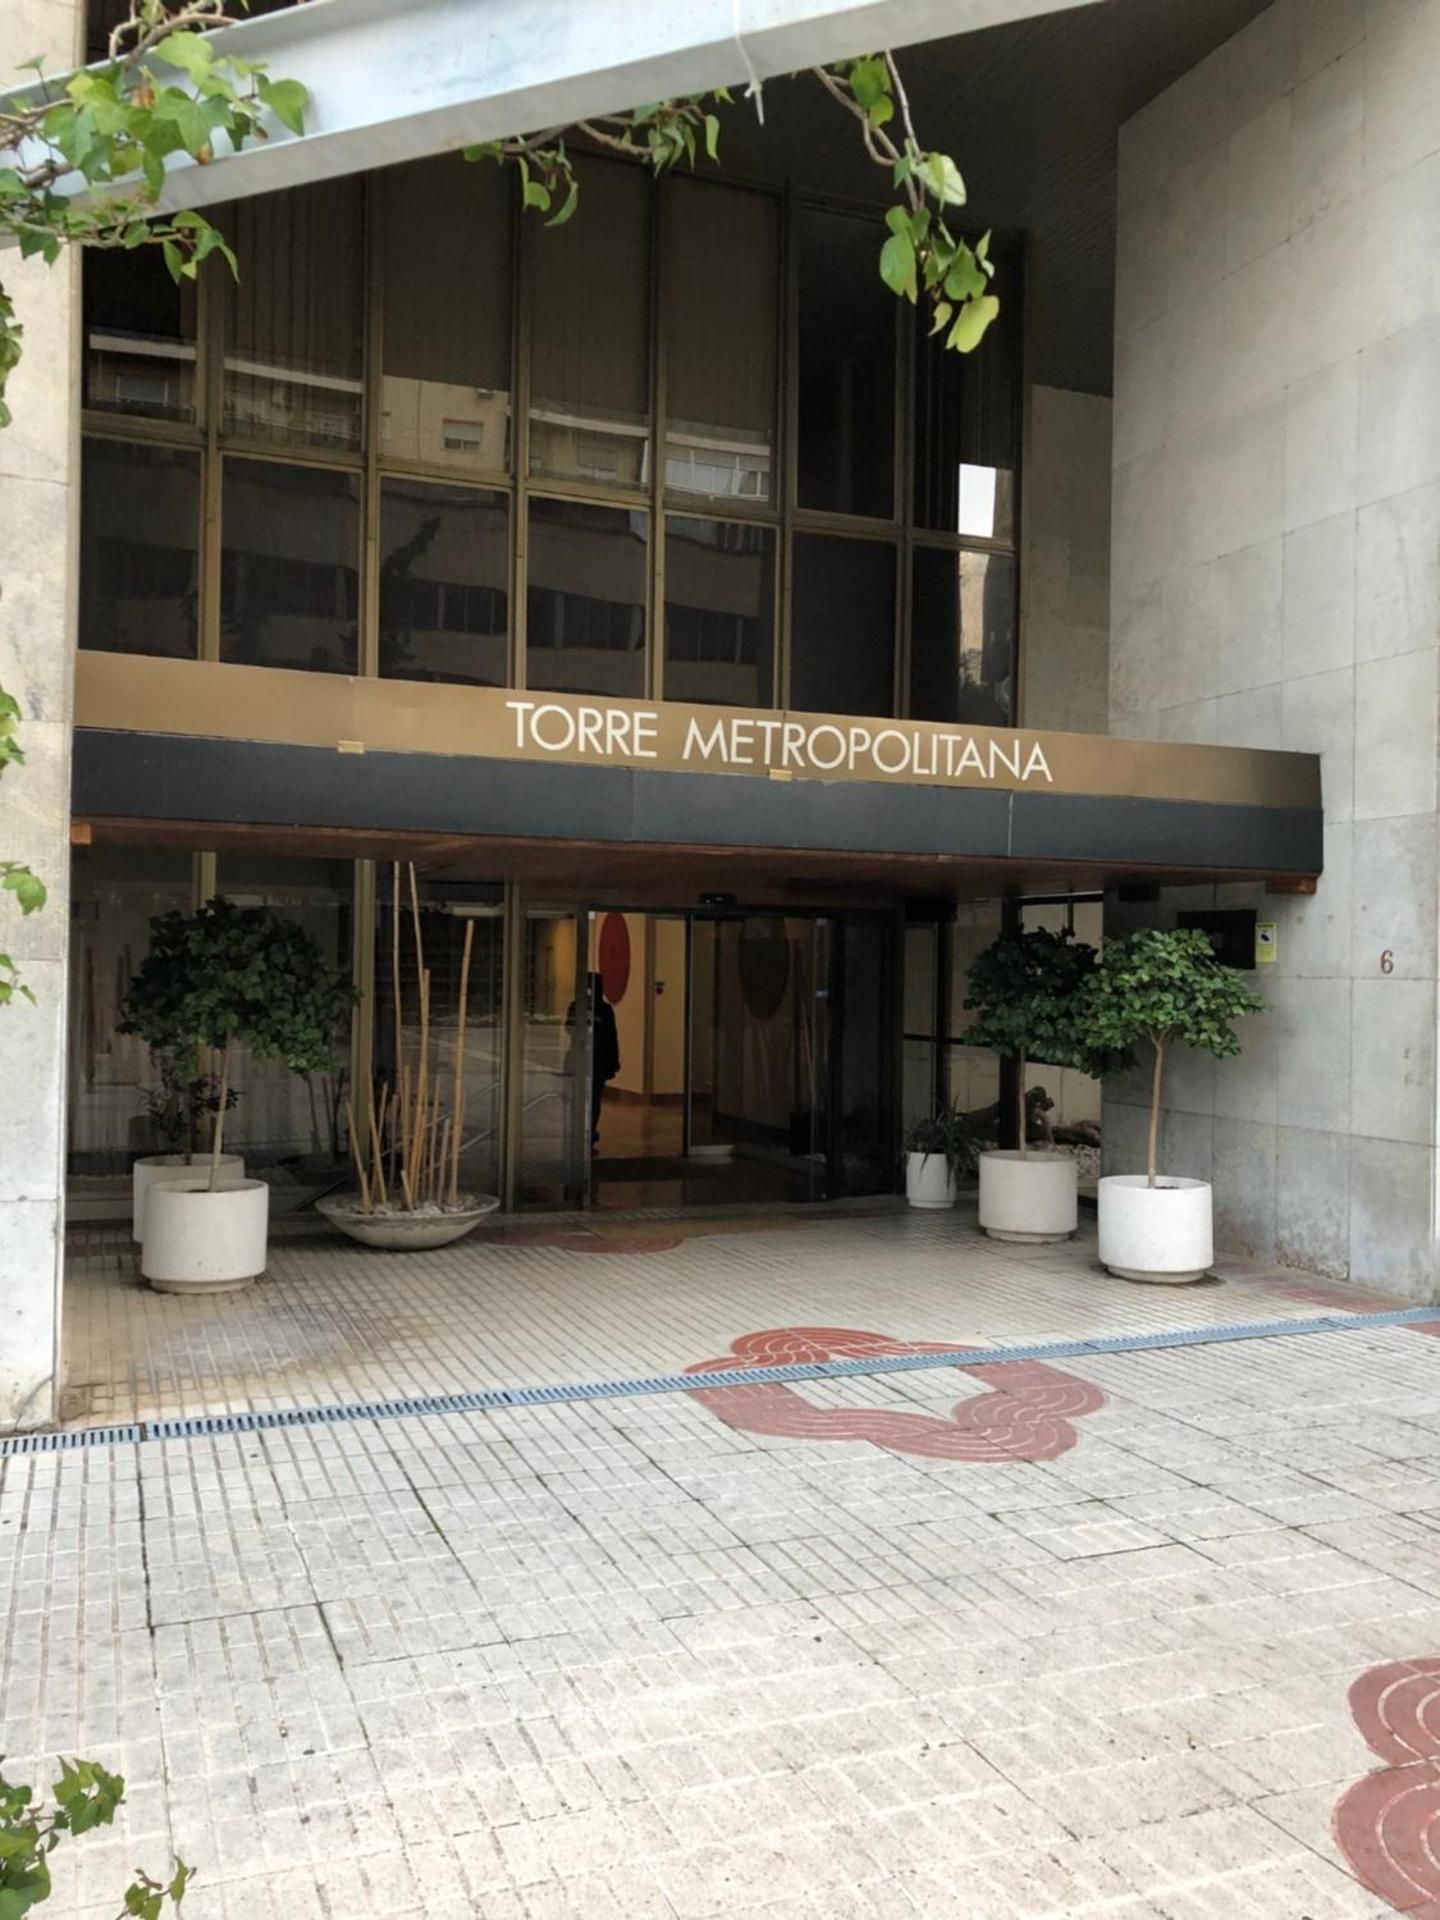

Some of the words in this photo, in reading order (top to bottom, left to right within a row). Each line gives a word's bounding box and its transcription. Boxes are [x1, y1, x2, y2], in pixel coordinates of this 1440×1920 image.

[506, 701, 658, 758] TORRE
[682, 717, 1054, 783] METROPOLITANA
[1380, 949, 1394, 974] 6
